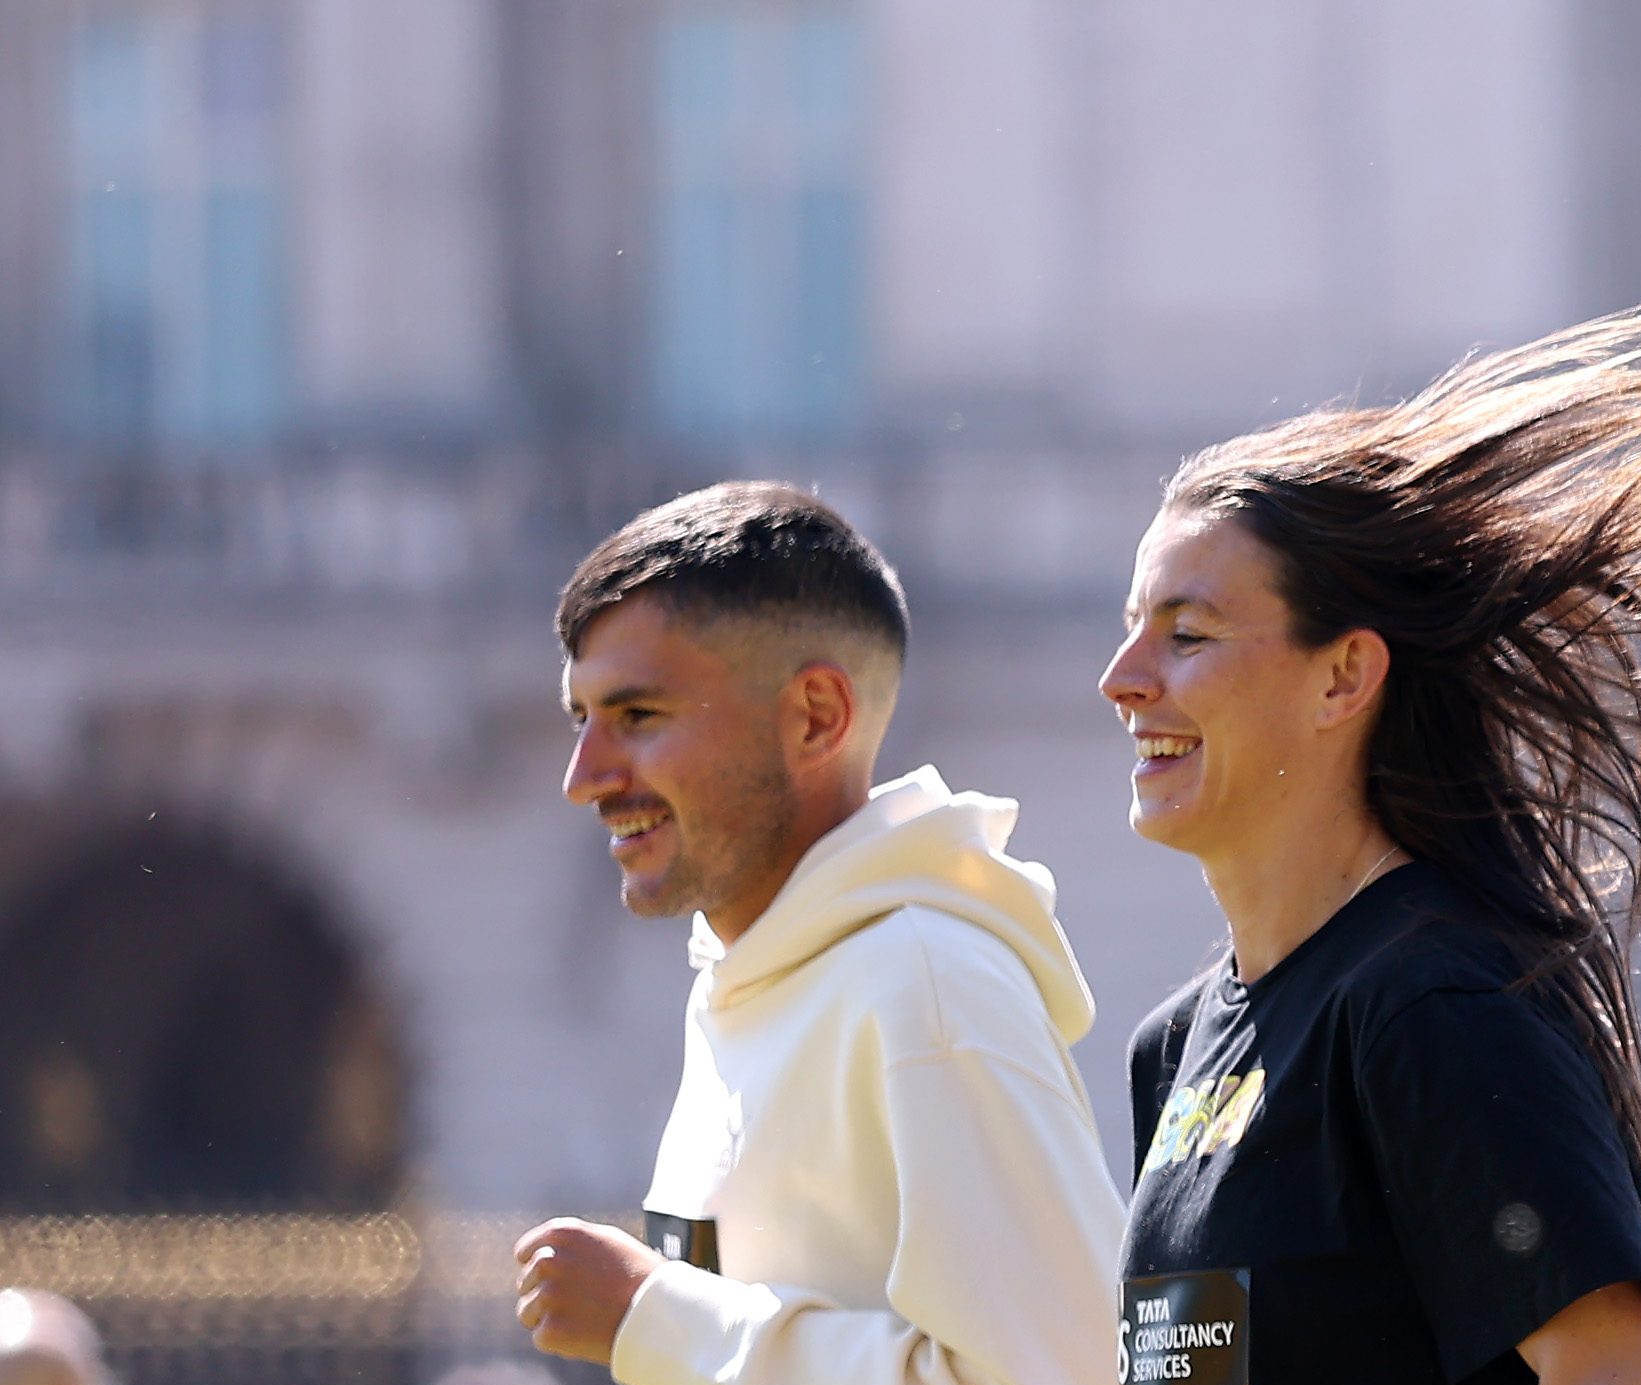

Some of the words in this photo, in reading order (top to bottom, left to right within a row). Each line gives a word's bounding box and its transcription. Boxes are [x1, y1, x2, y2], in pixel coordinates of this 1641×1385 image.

[1136, 1297, 1171, 1325] TATA
[1134, 1320, 1235, 1354] CONSULTANCY
[1132, 1353, 1192, 1383] SERVICES
